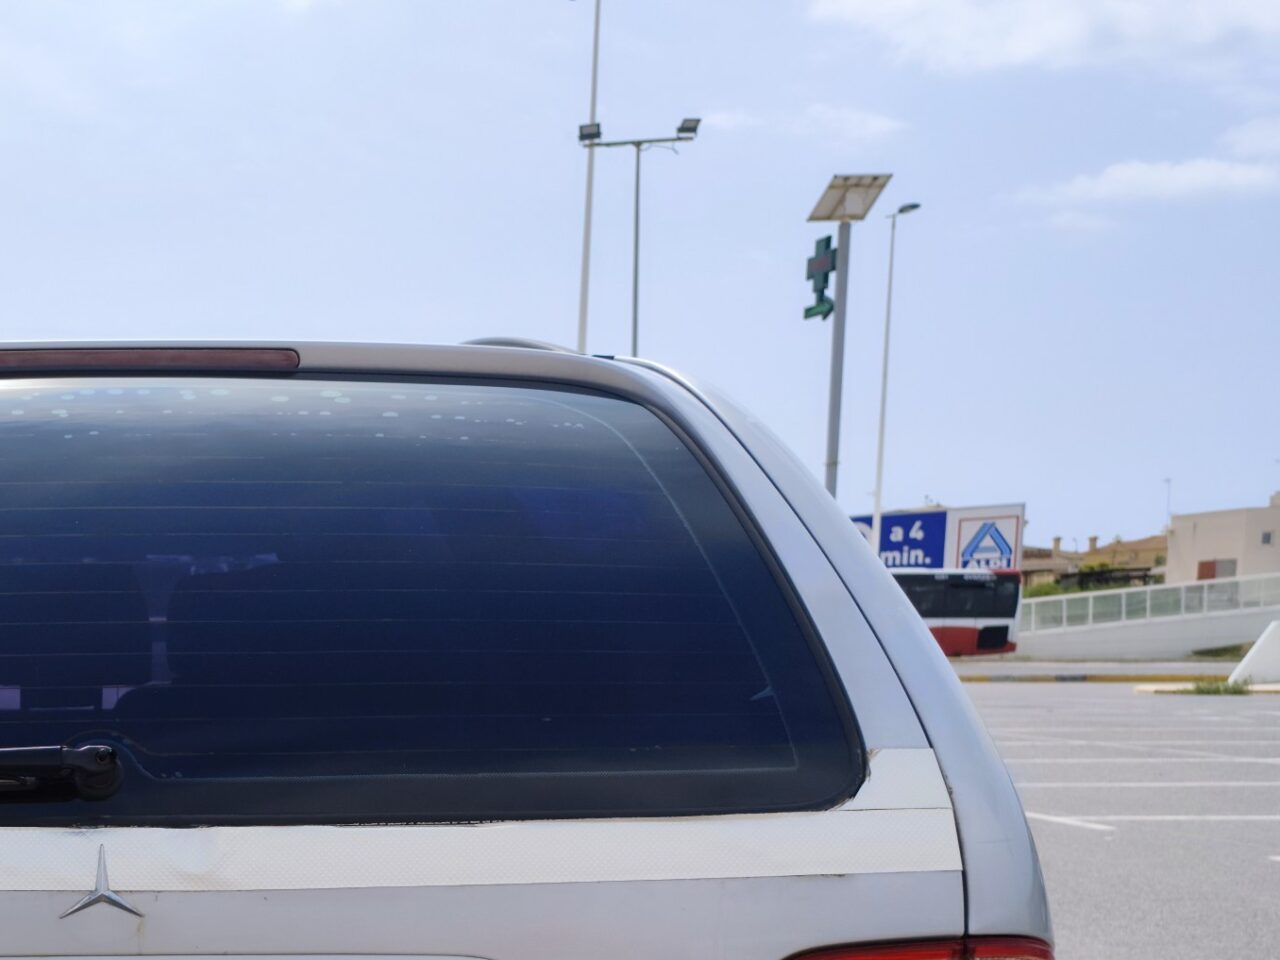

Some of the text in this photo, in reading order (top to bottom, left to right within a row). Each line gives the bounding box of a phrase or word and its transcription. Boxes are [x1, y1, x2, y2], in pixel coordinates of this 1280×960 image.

[889, 525, 904, 542] a
[909, 520, 925, 541] 4
[880, 545, 931, 567] min.
[965, 558, 1009, 570] ALDI
